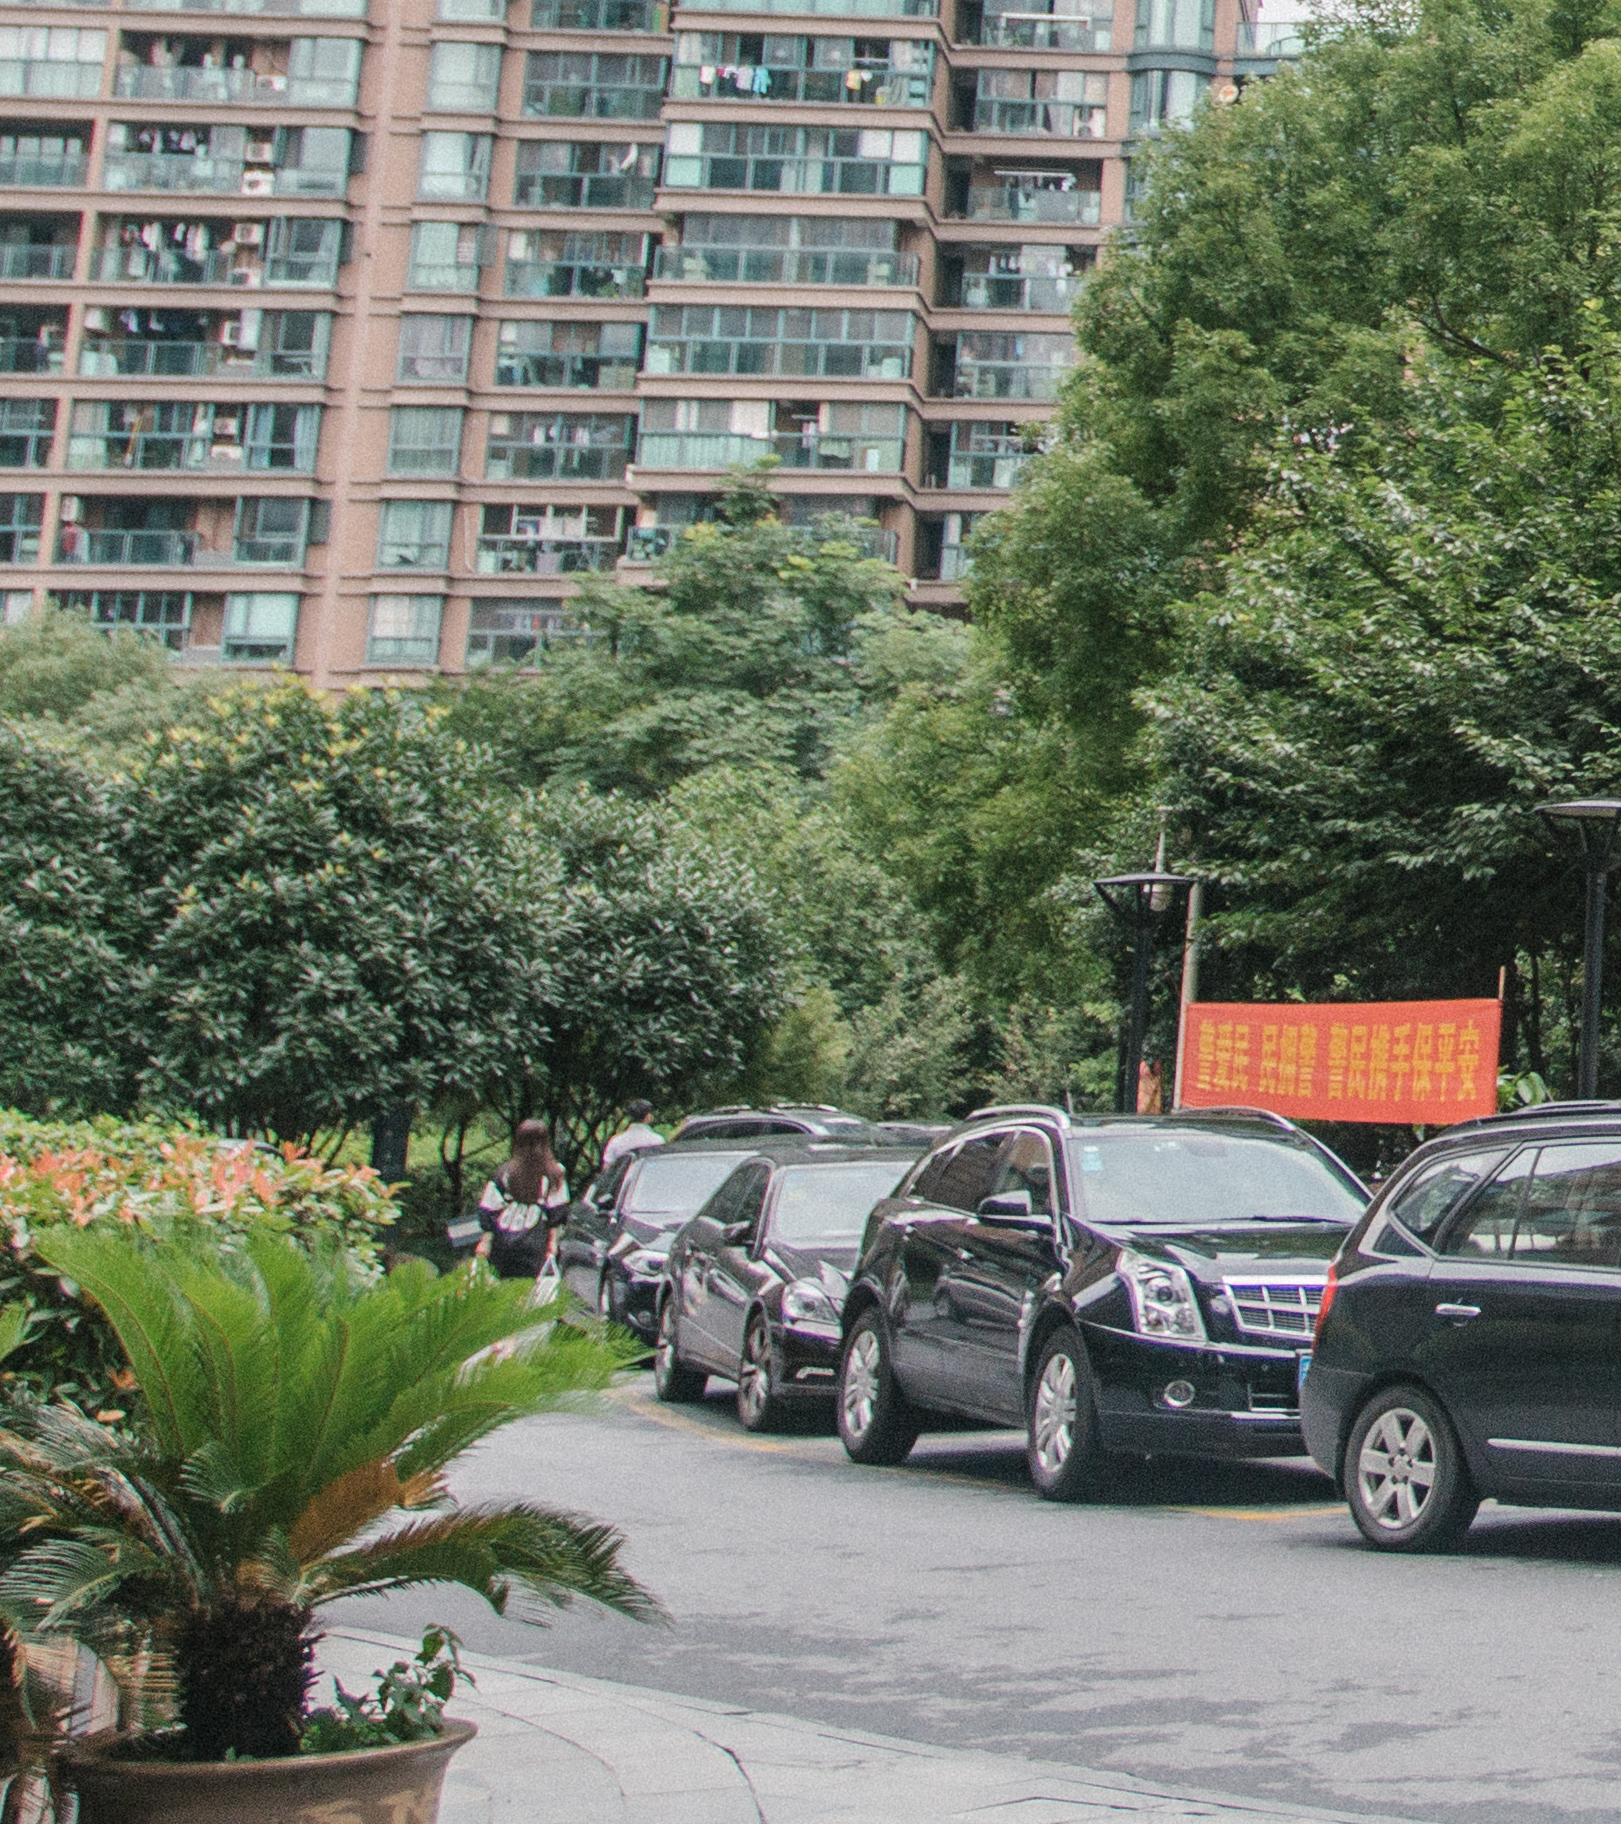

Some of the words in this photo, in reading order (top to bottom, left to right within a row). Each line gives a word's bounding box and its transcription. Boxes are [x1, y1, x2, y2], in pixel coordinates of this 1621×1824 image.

[1328, 1019, 1480, 1102] 警民携手保平安
